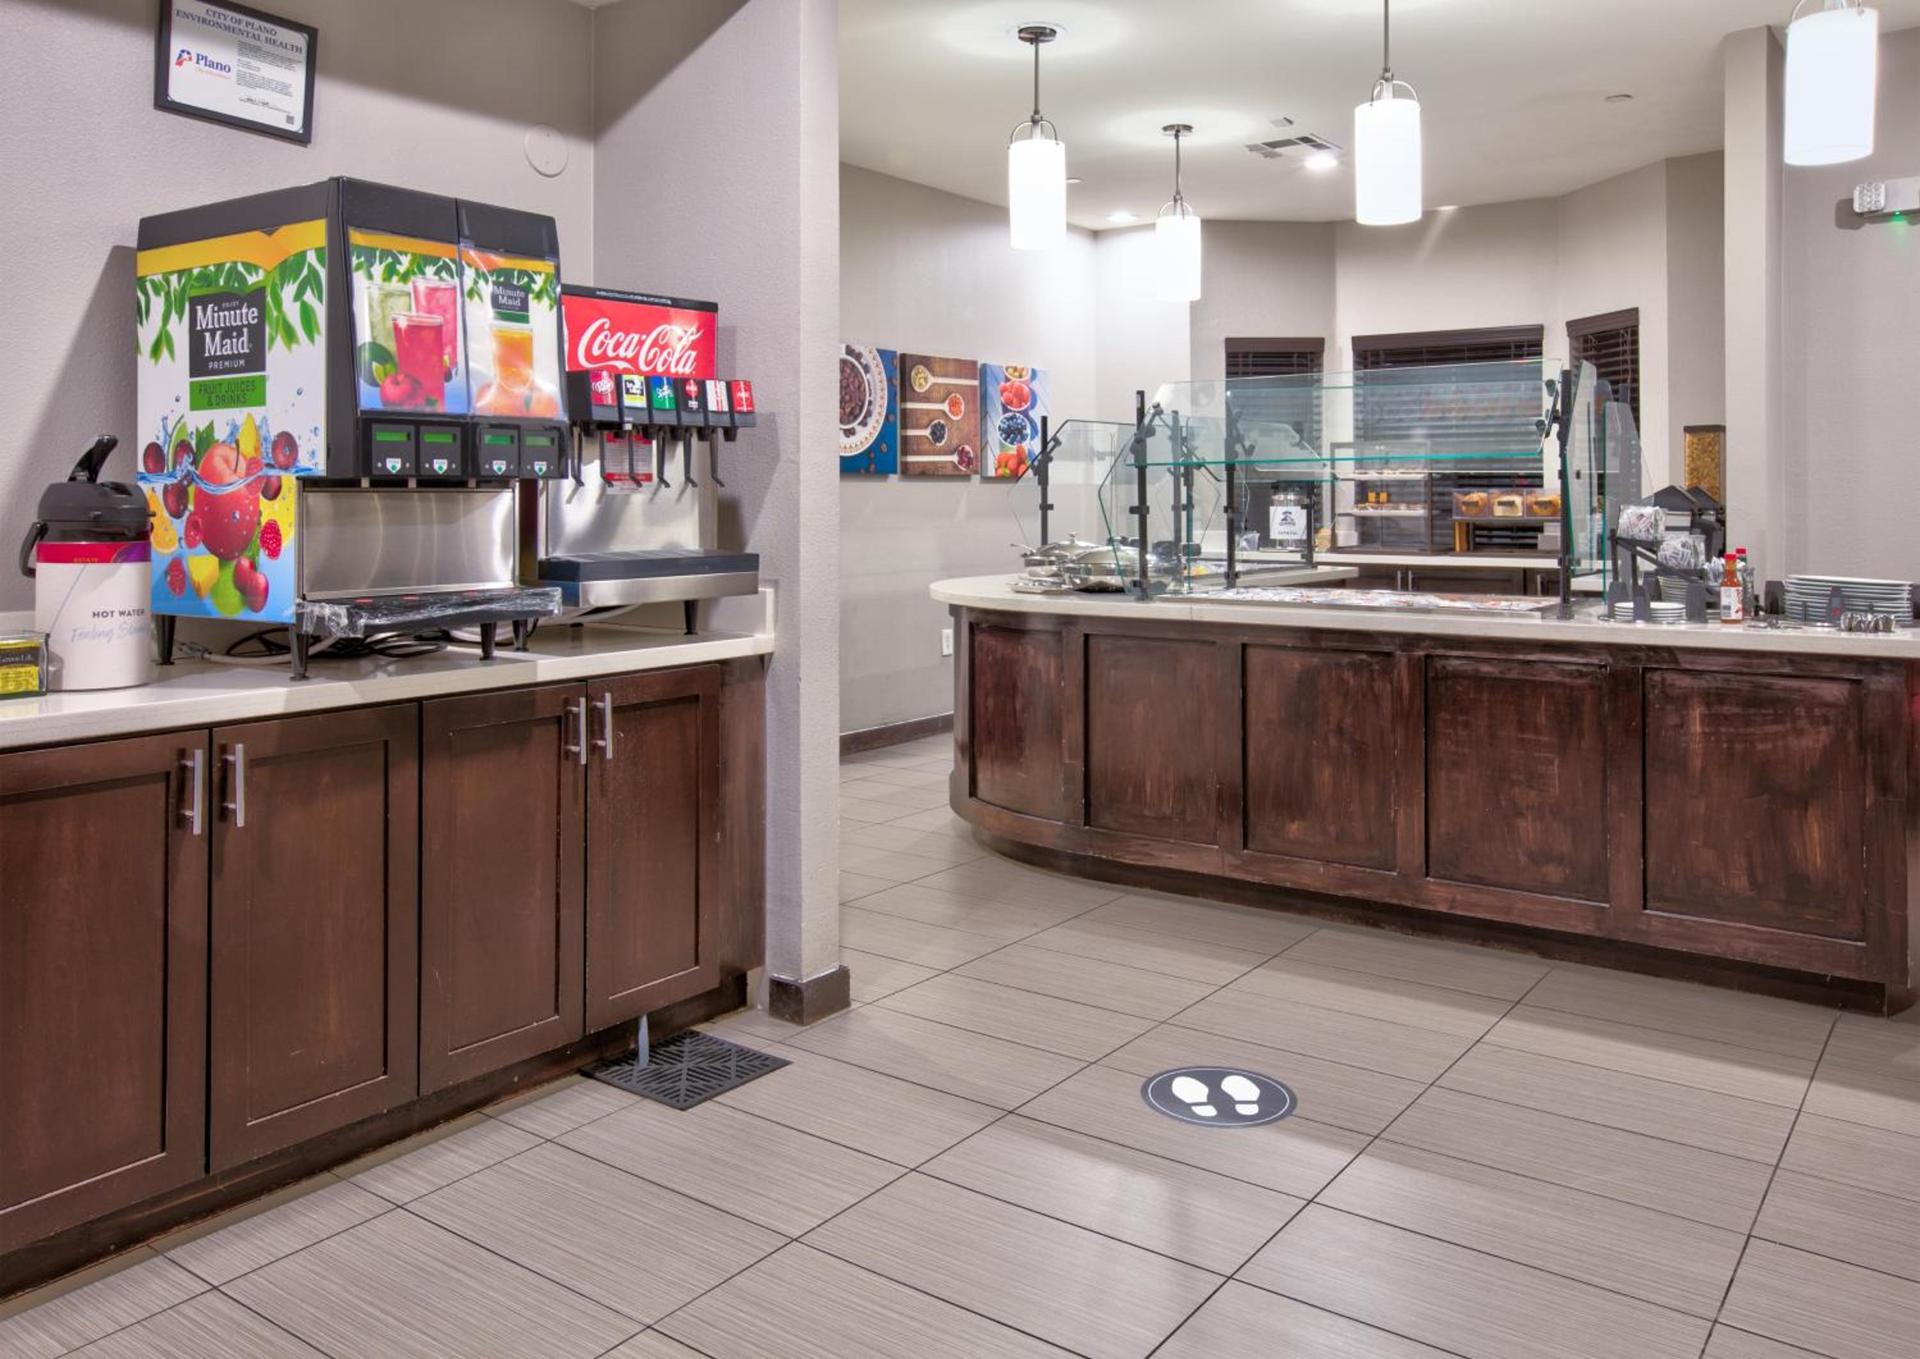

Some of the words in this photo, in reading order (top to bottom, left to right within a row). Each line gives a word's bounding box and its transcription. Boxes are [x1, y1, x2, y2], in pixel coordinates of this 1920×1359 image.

[176, 9, 262, 42] ENVIRONMENTAL
[264, 36, 303, 54] HEALTH
[205, 8, 229, 22] CITY
[230, 16, 243, 26] OF
[245, 20, 278, 37] PLANO
[195, 52, 232, 74] Plano
[195, 302, 259, 331] Minute
[203, 327, 250, 357] Maid
[577, 317, 704, 375] Coca-Cola
[208, 359, 246, 370] PREMIUM
[198, 383, 224, 396] FRUIT
[225, 380, 257, 394] JUICES
[215, 393, 248, 406] DRINKS
[92, 610, 116, 620] HOT
